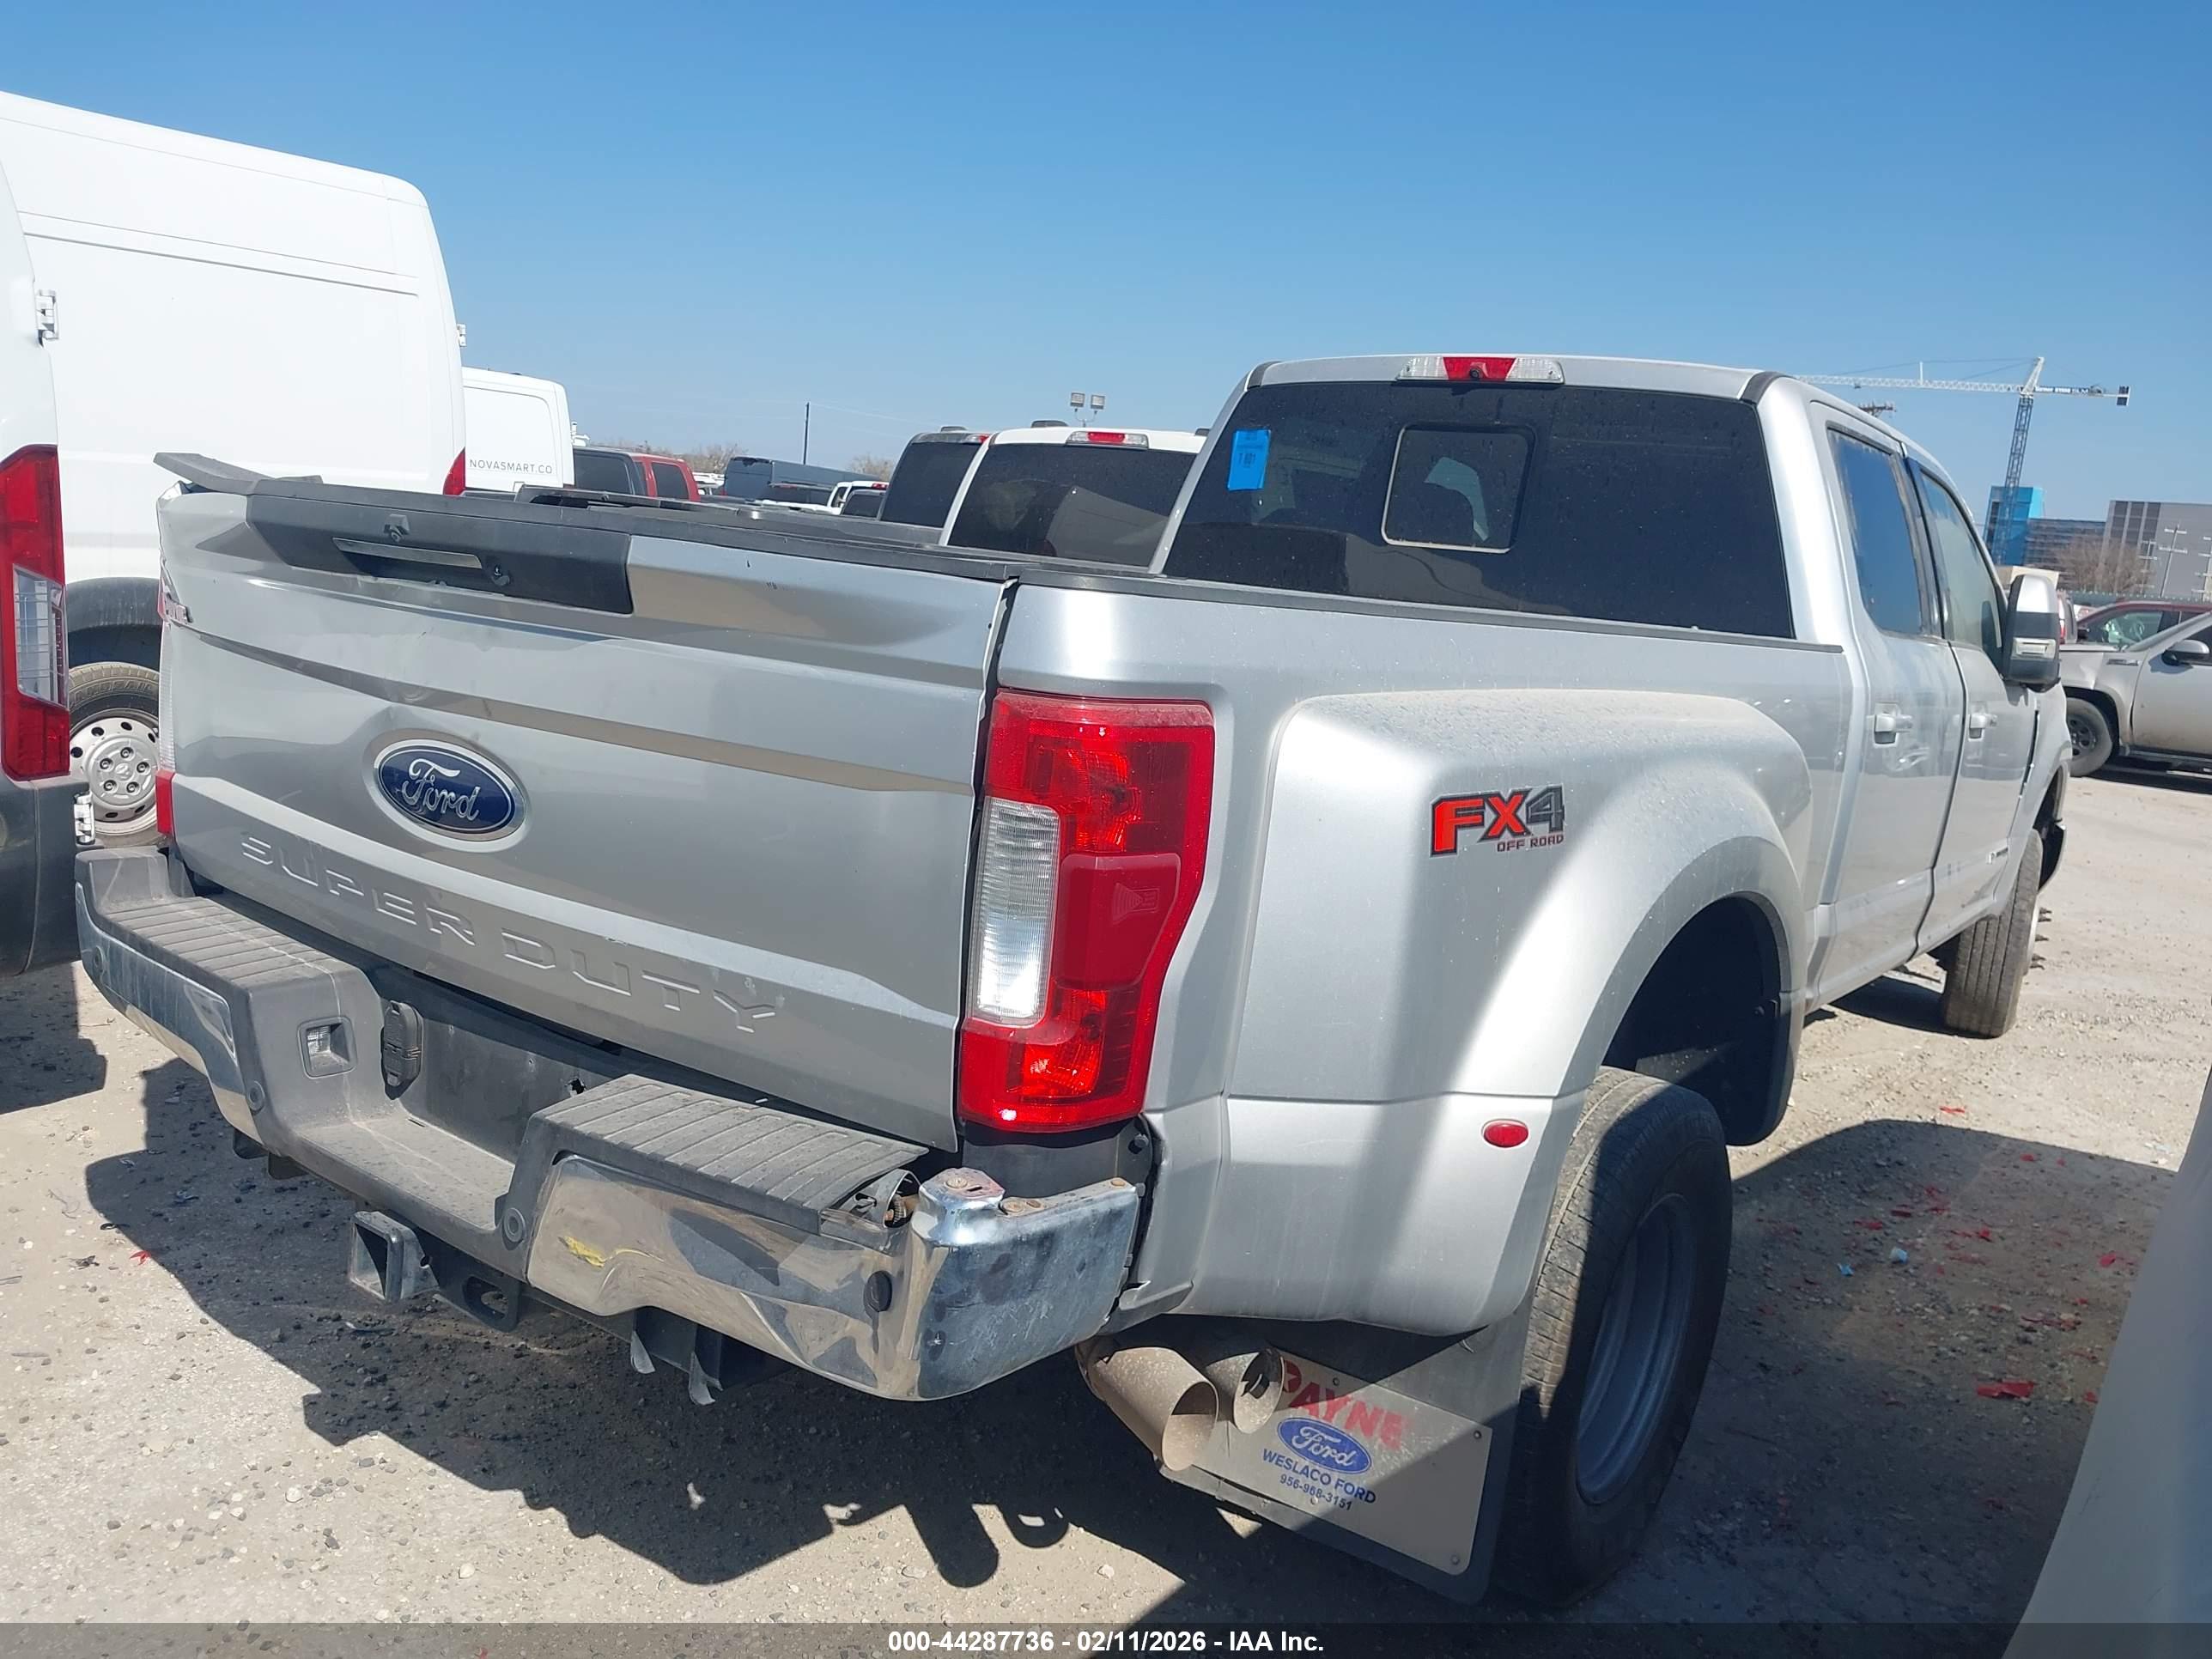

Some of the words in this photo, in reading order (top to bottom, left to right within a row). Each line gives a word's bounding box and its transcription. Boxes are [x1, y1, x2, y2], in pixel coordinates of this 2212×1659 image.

[469, 459, 553, 474] NOVASMART.CO
[400, 757, 482, 822] Ford
[1430, 783, 1565, 857] FX4
[1496, 839, 1526, 853] OFF
[1529, 833, 1565, 849] ROAD
[240, 835, 476, 946] SUPER
[501, 927, 776, 1033] DUTY
[1291, 1425, 1358, 1467] Ford
[1262, 1448, 1332, 1486] WESLACO
[1334, 1477, 1377, 1504] FORD
